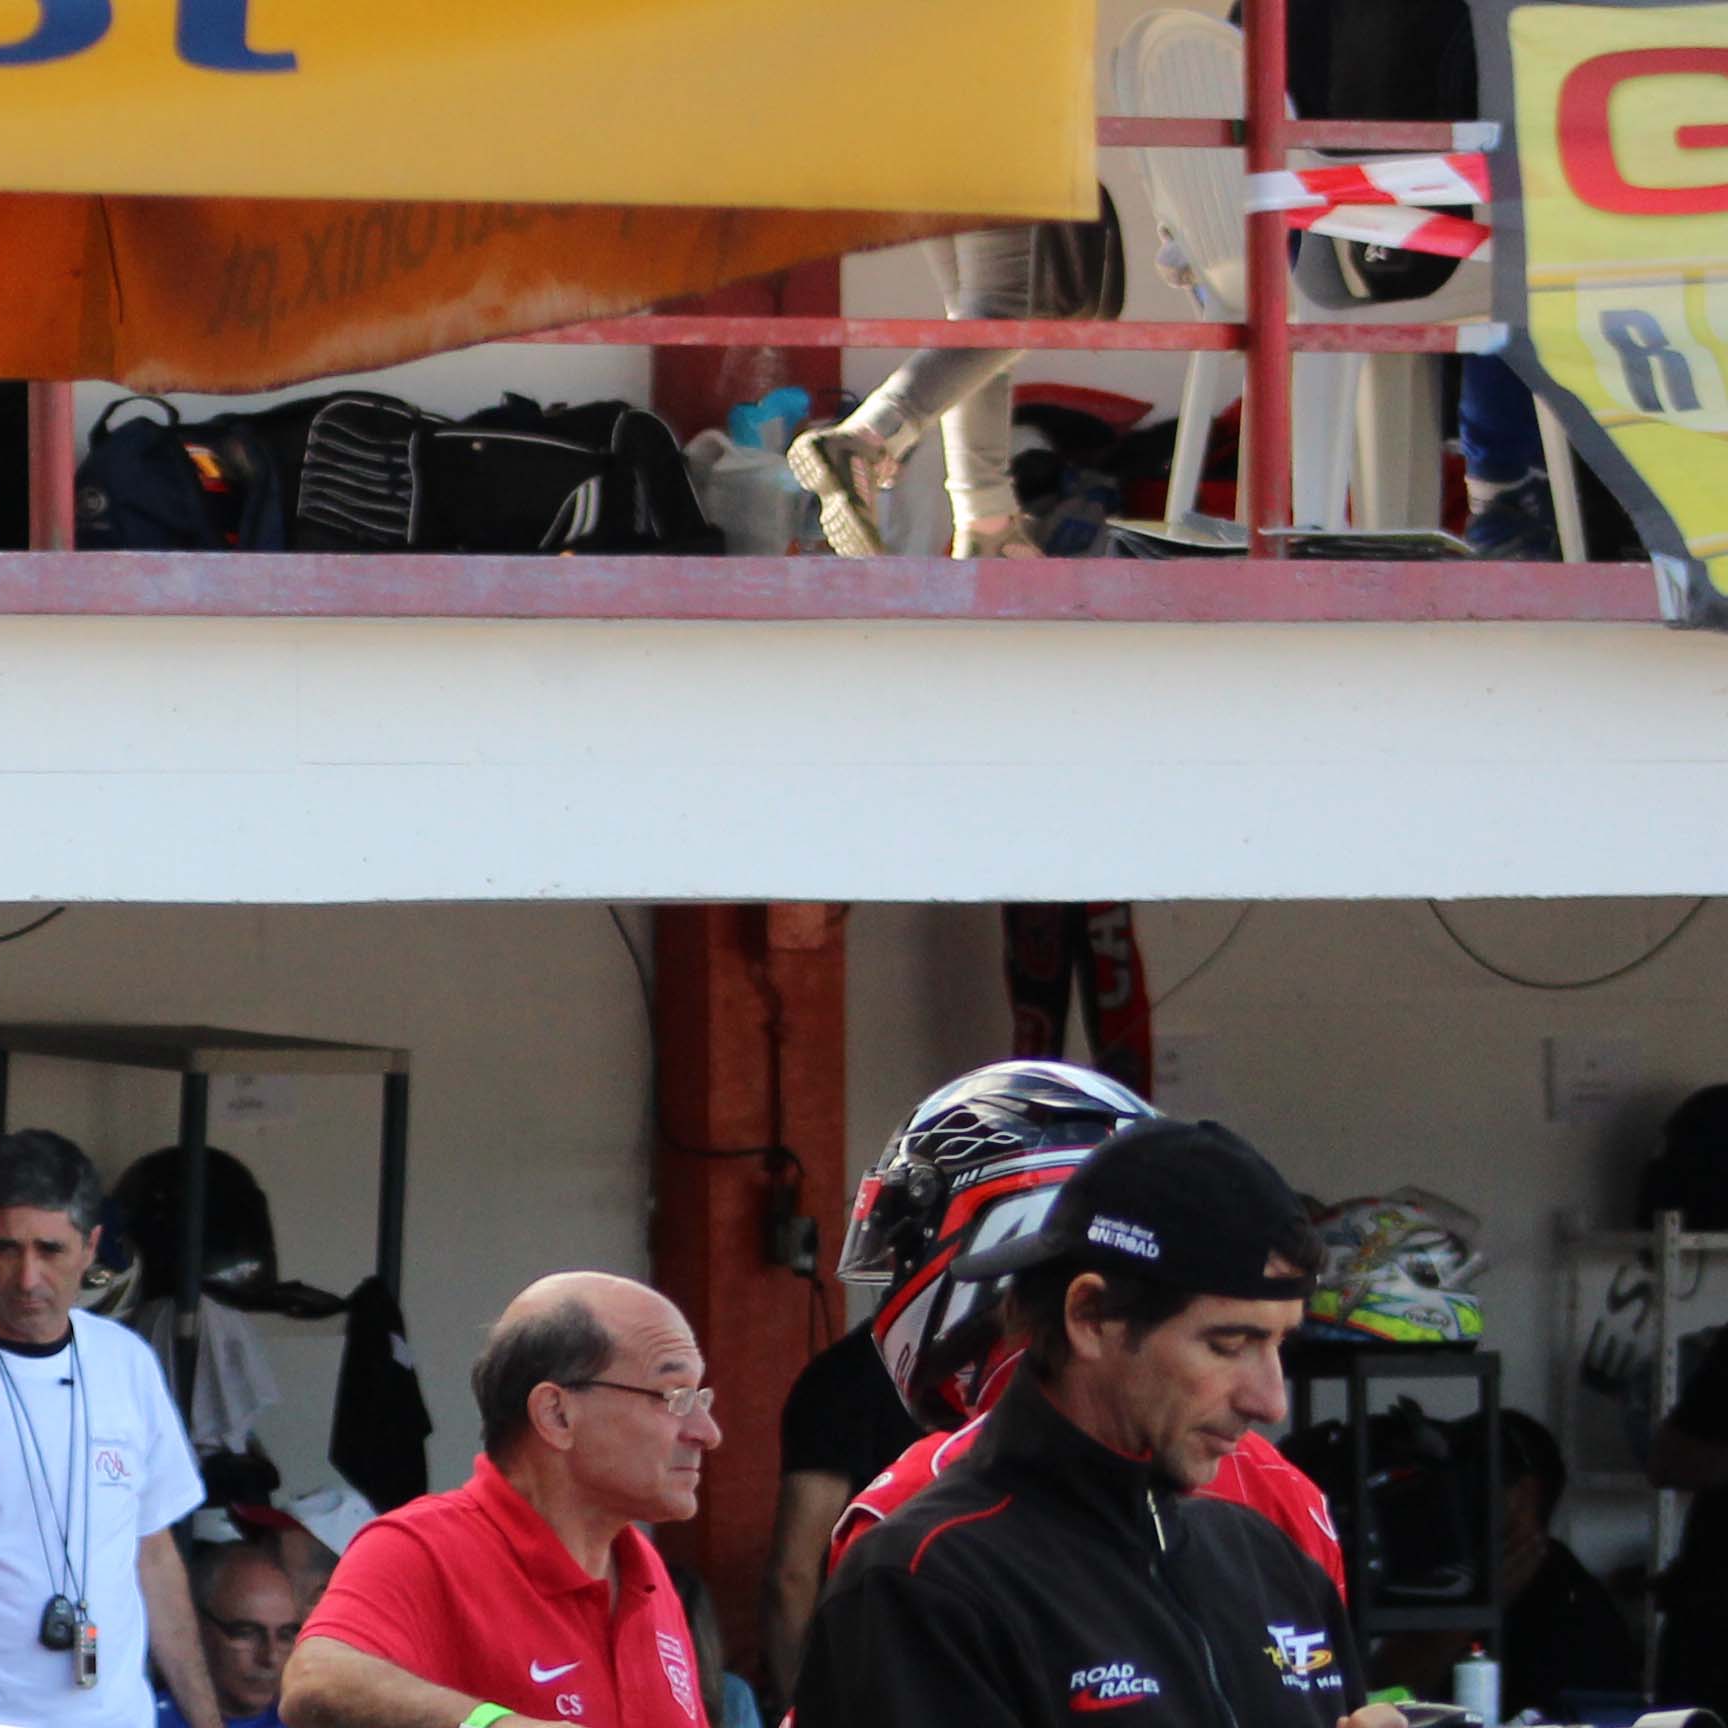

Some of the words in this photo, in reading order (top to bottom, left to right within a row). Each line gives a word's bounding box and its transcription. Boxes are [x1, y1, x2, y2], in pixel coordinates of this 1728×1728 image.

[1070, 1663, 1135, 1689] ROAD
[1098, 1677, 1161, 1699] RACES
[555, 1693, 584, 1717] CS
